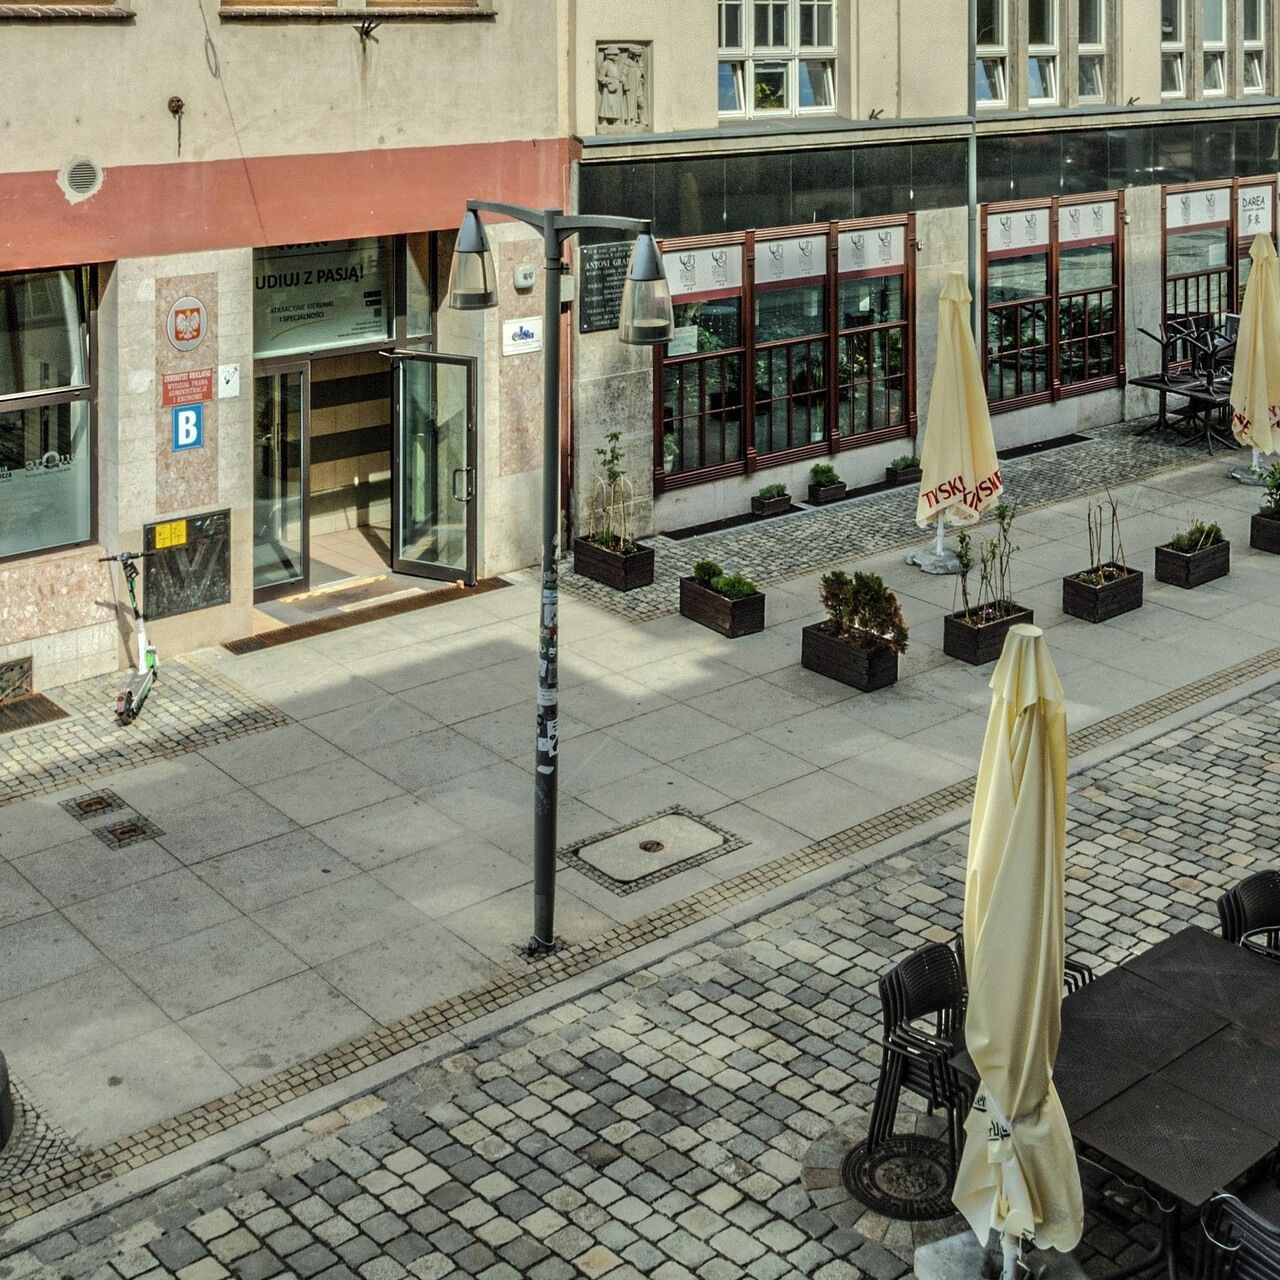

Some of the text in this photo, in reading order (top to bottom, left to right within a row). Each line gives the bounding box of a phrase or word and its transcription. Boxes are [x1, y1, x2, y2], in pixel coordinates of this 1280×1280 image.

[1242, 196, 1265, 208] DAREA
[585, 258, 630, 270] ANTONI GRA
[256, 265, 364, 290] UDIUJ Z PASJĄ!
[178, 410, 198, 446] B
